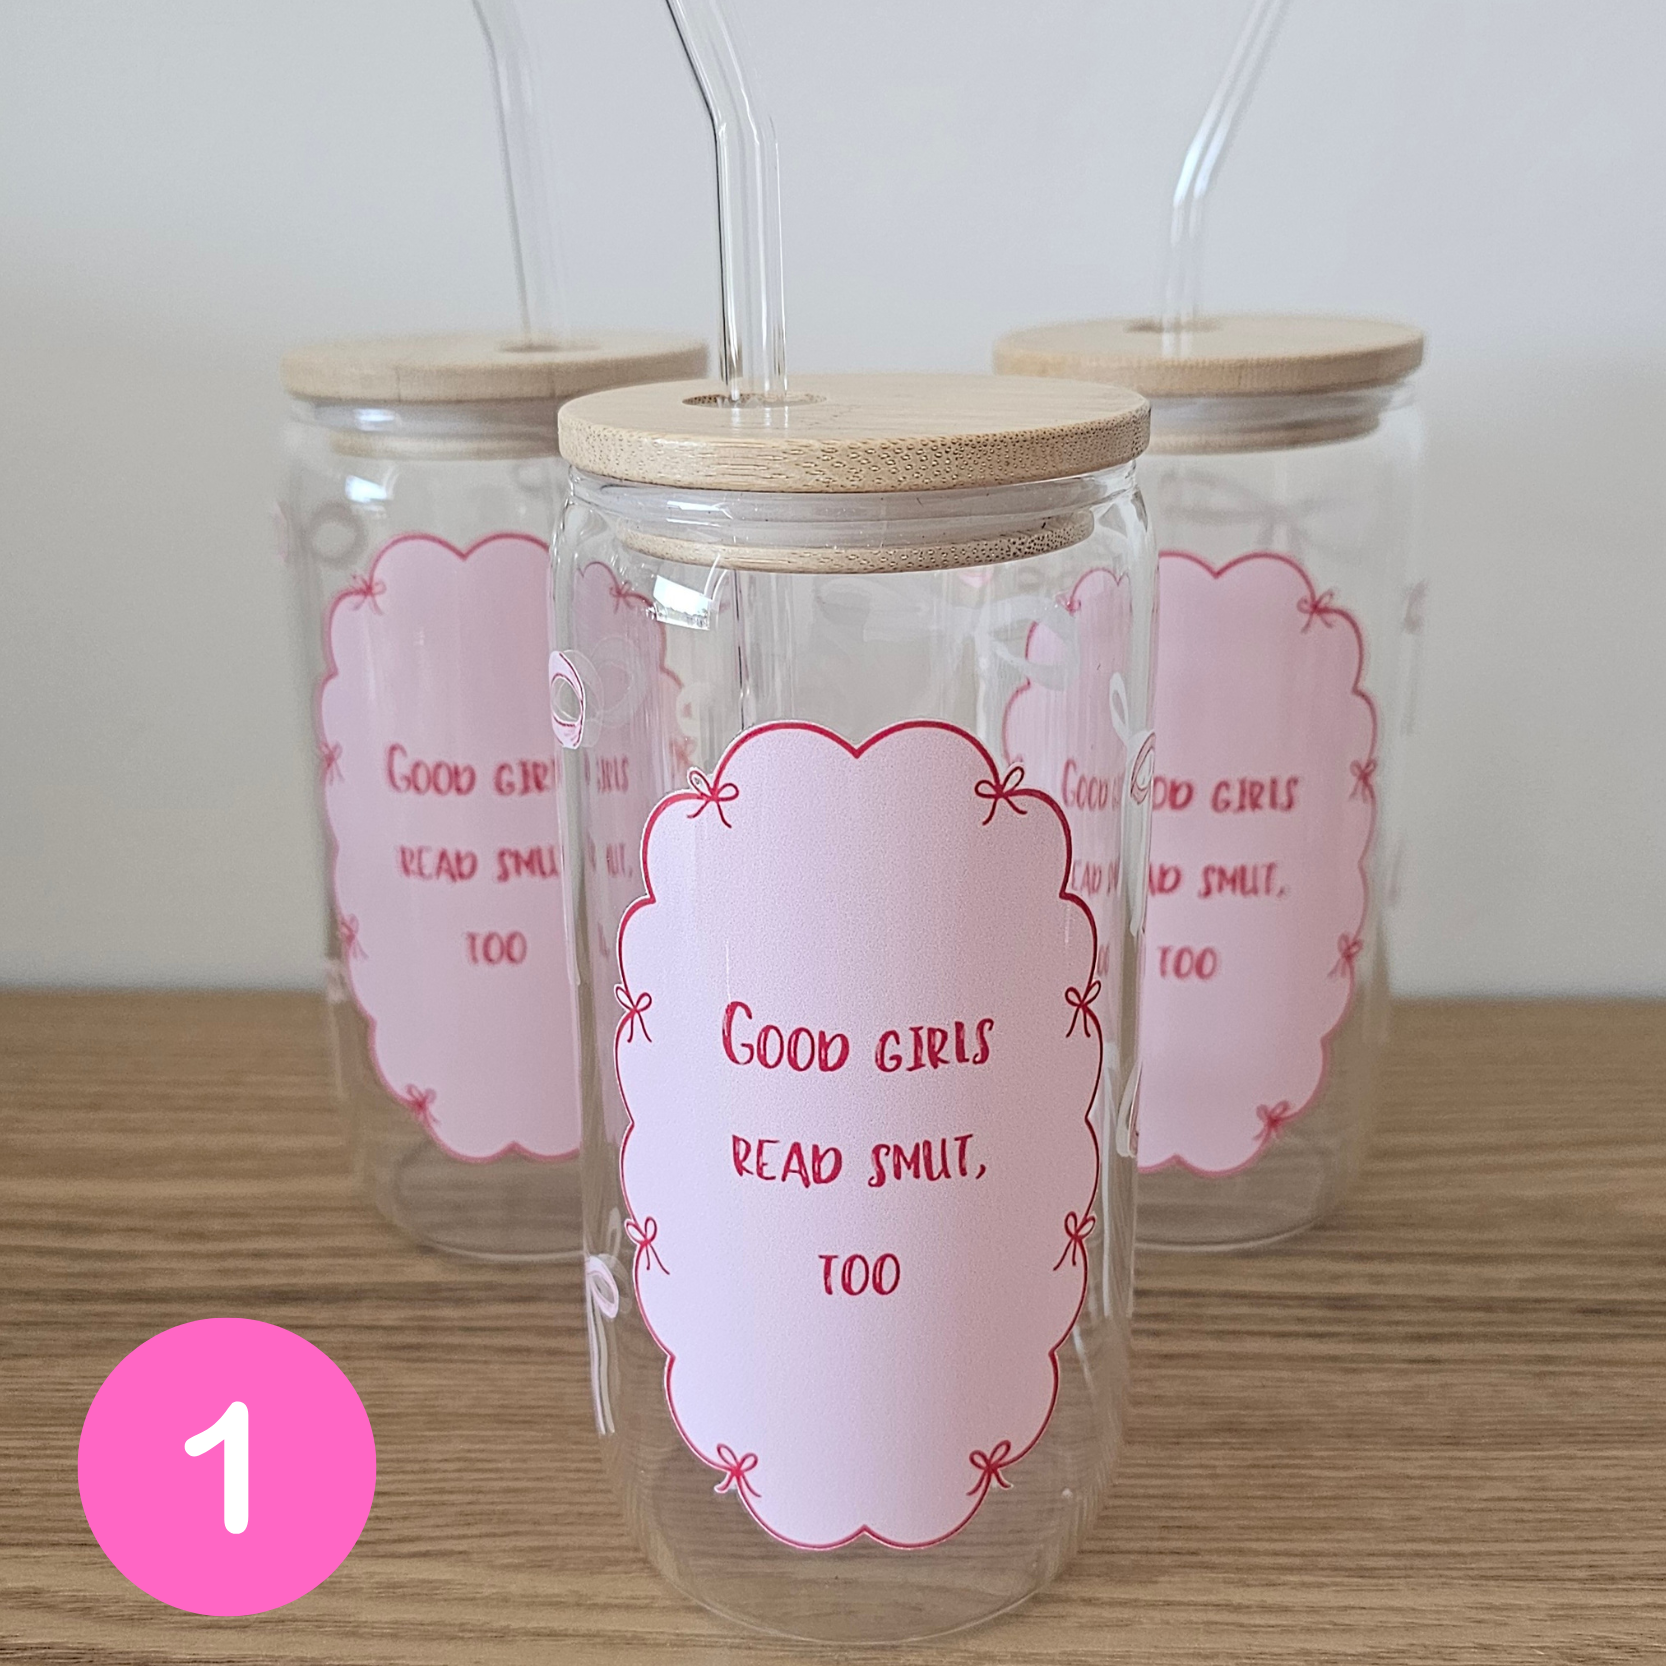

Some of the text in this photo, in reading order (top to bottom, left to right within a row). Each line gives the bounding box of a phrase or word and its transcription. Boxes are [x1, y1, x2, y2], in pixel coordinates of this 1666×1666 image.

[1211, 775, 1299, 814] GIRLS
[497, 844, 559, 882] SMU
[466, 931, 527, 965] TOO
[1155, 945, 1218, 980] TOO
[722, 1001, 994, 1073] GOOD GIRLS
[732, 1134, 987, 1189] READ SMUT,
[818, 1253, 901, 1296] TOO
